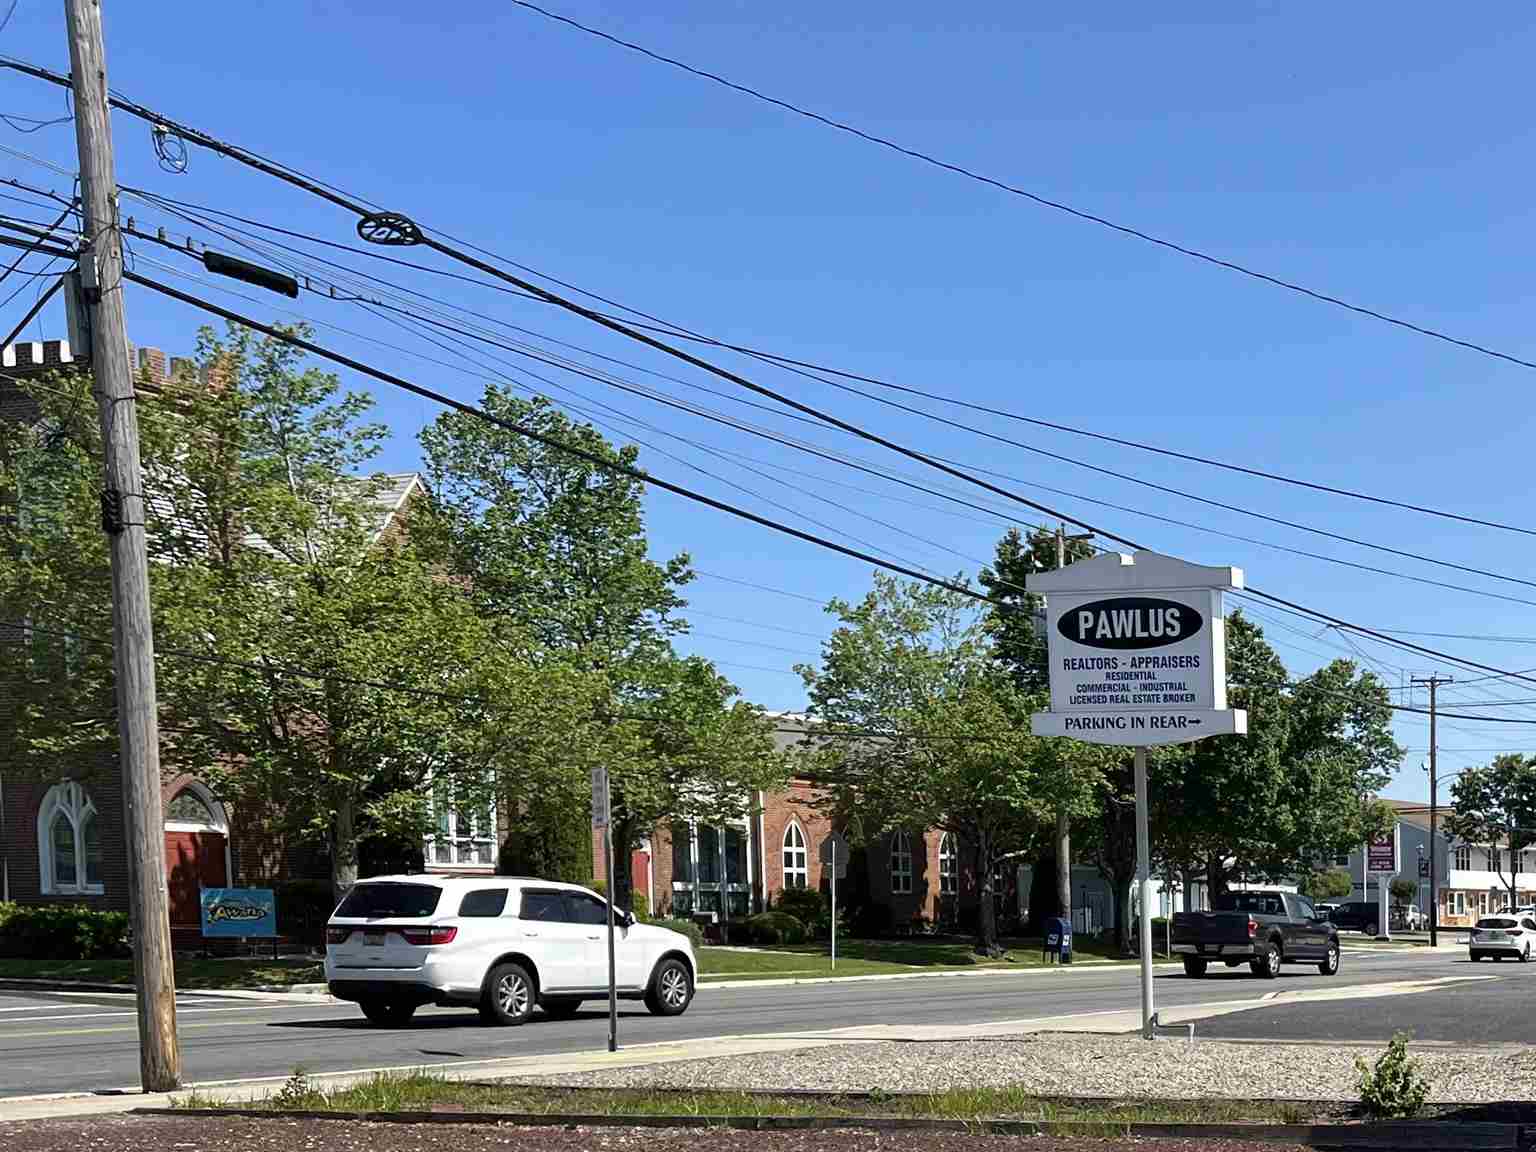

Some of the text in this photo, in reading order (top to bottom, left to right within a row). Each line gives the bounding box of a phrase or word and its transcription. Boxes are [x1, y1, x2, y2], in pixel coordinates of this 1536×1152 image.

[1078, 607, 1181, 640] PAWLUS
[1063, 656, 1119, 671] REALTORS
[1129, 655, 1201, 669] APPRAISERS
[1105, 671, 1158, 681] RESIDENTIAL
[1076, 682, 1132, 693] COMMERCIAL
[1139, 682, 1188, 692] INDUSTRIAL
[1069, 692, 1196, 705] LICENSED REAL ESTATE BROKER
[1064, 715, 1187, 730] PARKING IN REAR
